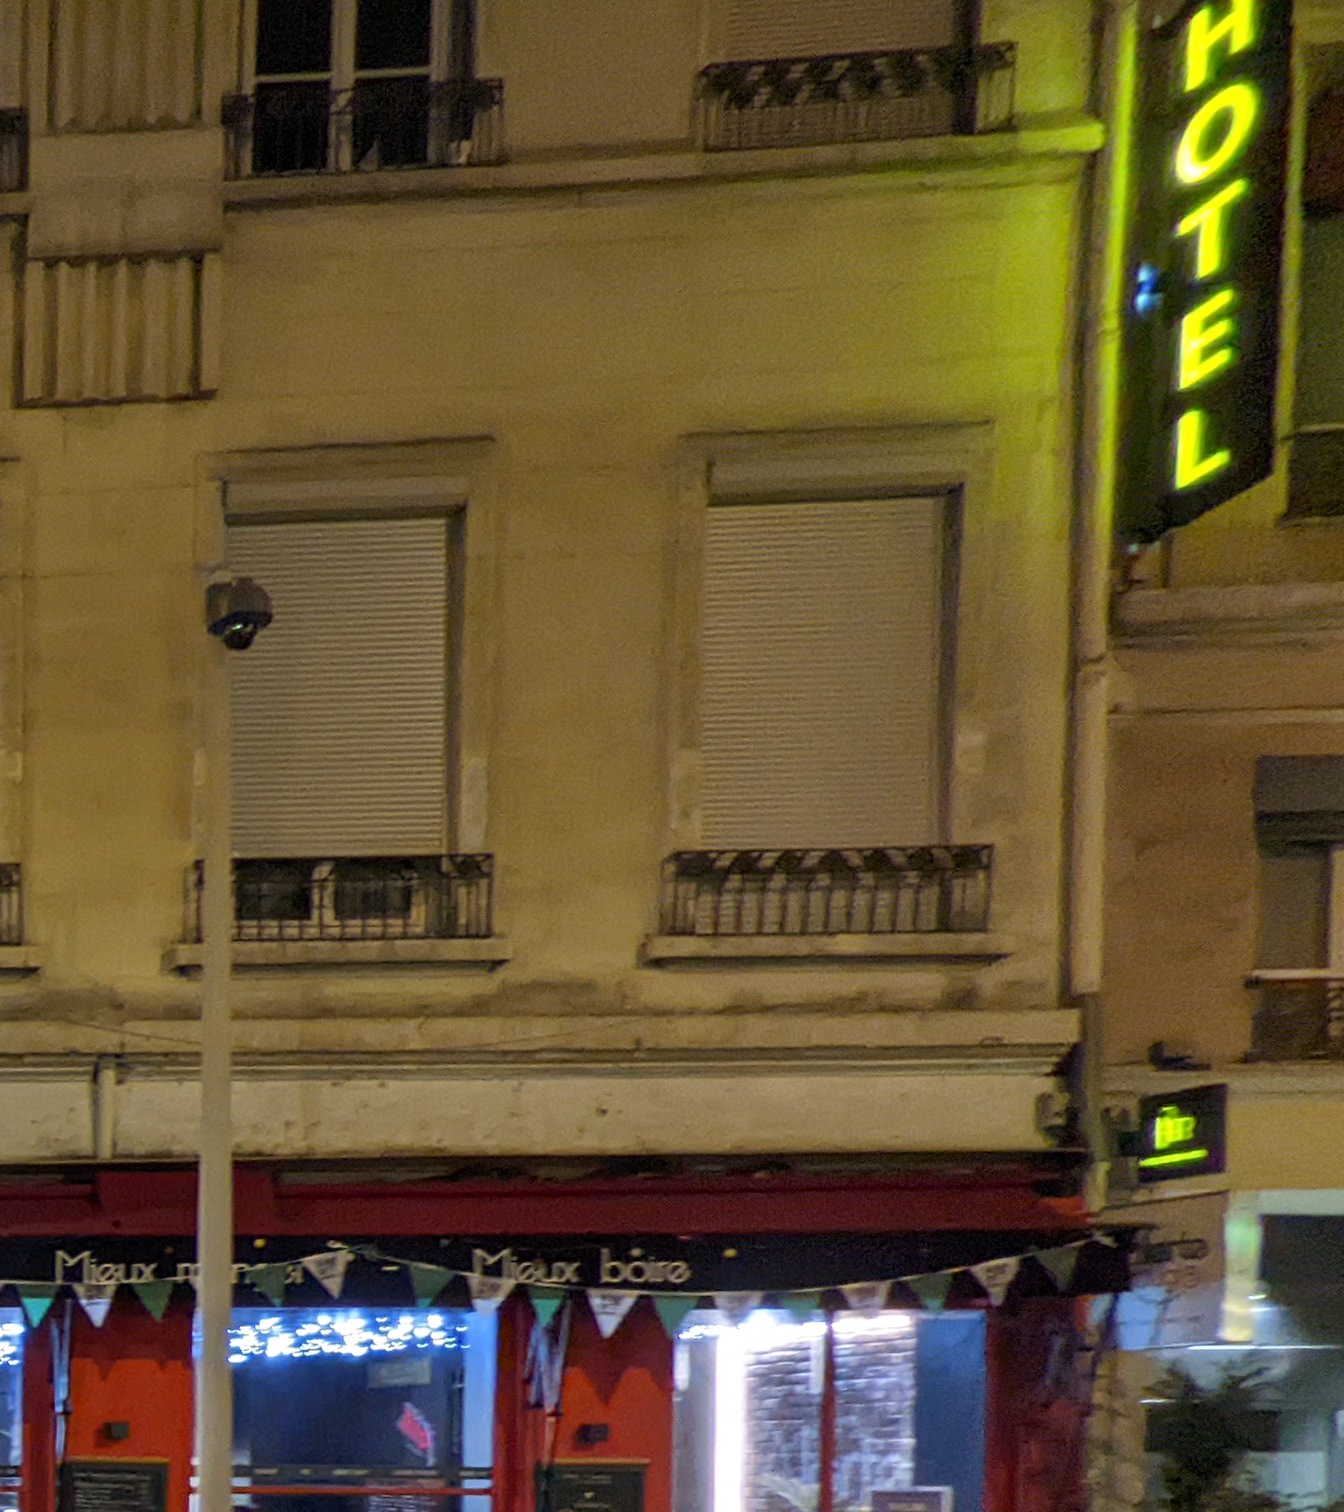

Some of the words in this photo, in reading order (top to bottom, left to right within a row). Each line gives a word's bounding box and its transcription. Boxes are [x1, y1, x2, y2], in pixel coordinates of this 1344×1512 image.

[1175, 0, 1258, 490] HOTEL
[55, 1250, 157, 1284] Mieux
[472, 1248, 581, 1283] Mieux
[599, 1248, 691, 1284] boire
